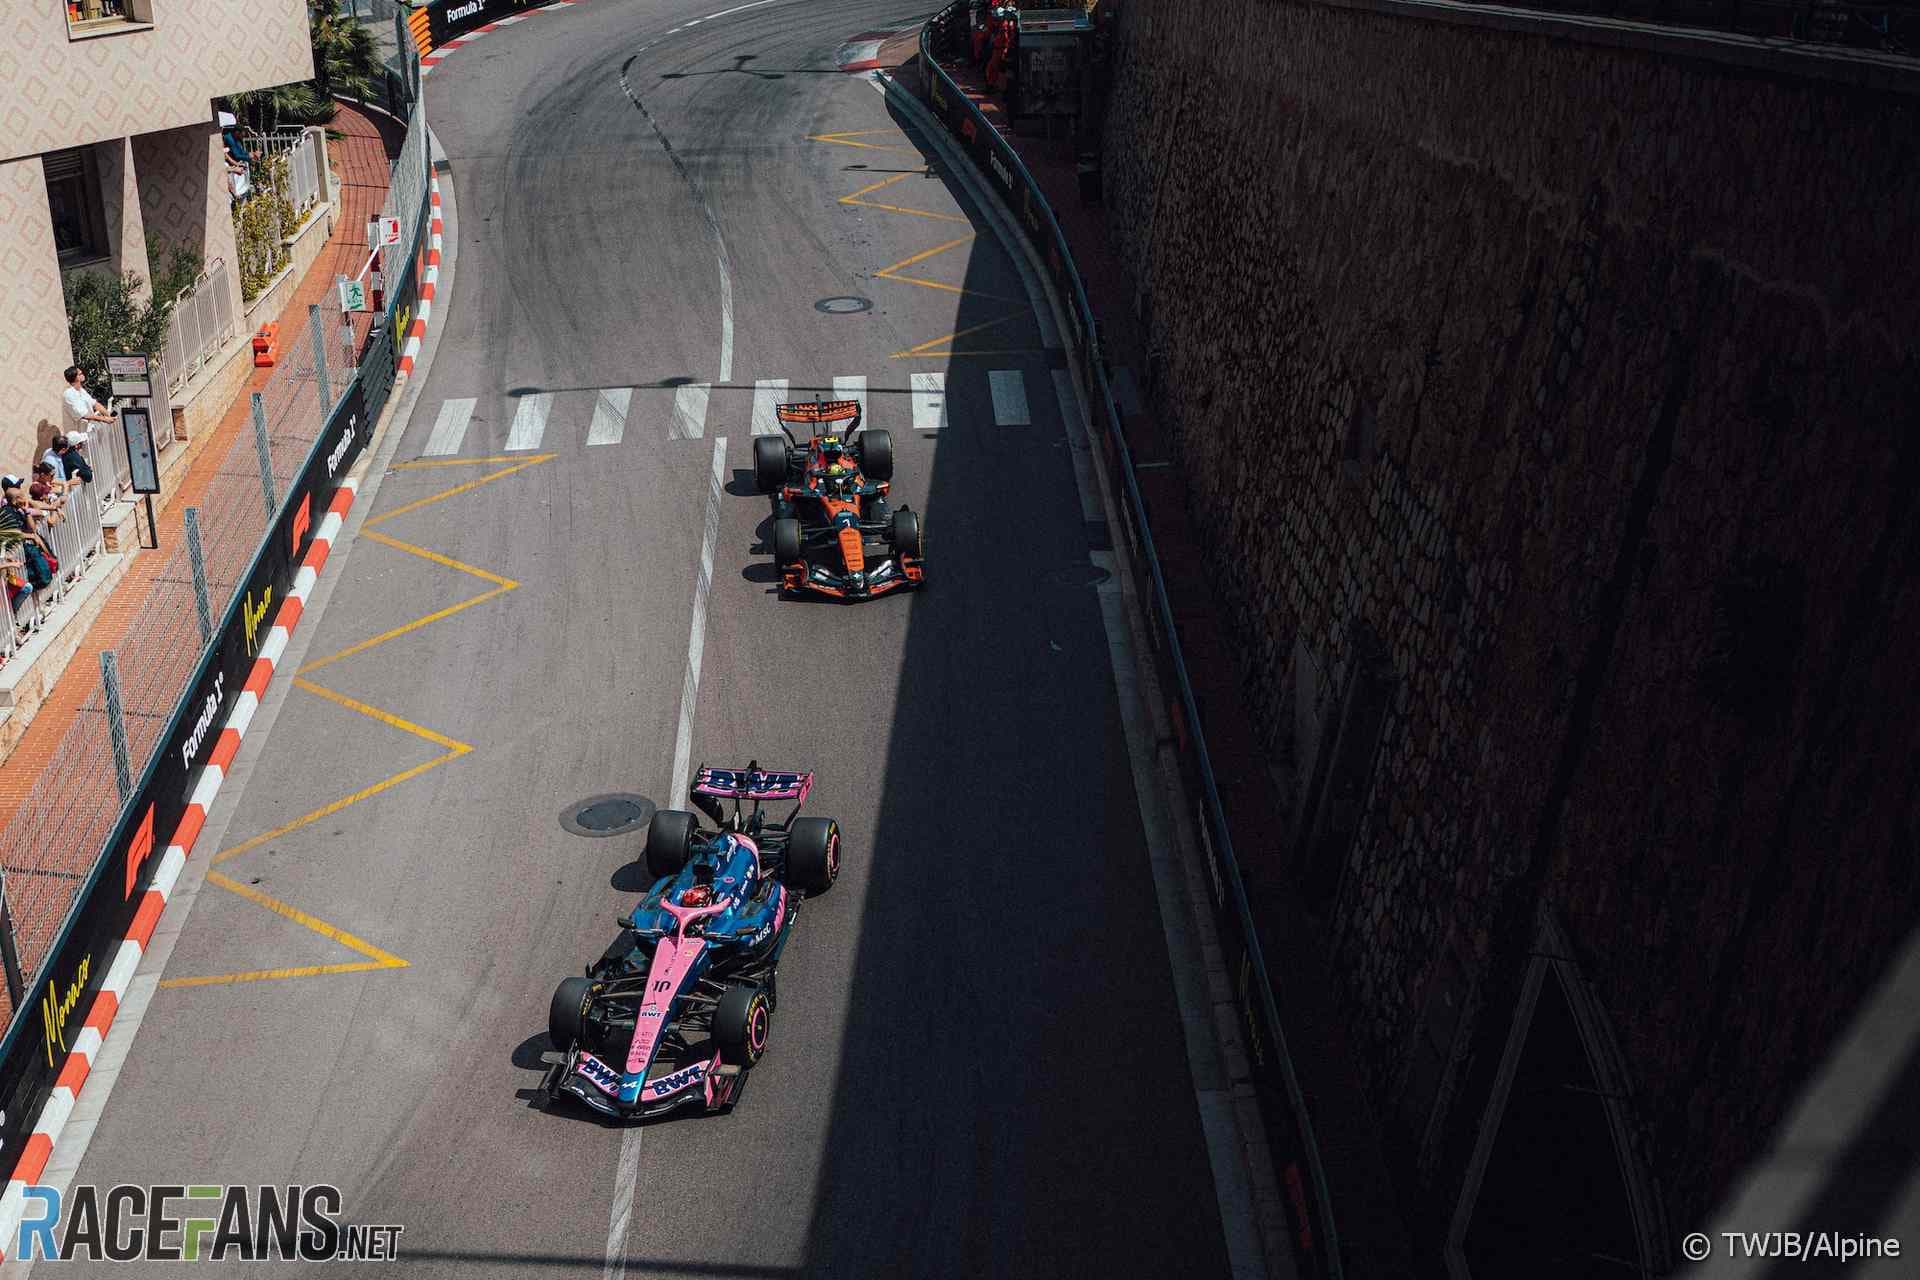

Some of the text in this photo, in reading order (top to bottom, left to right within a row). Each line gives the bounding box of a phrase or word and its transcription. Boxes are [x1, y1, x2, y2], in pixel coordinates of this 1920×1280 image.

[446, 1, 478, 23] Formula
[327, 427, 351, 479] Formula
[181, 694, 218, 771] Formula
[43, 953, 91, 1069] Monaco
[651, 1065, 703, 1096] BWT
